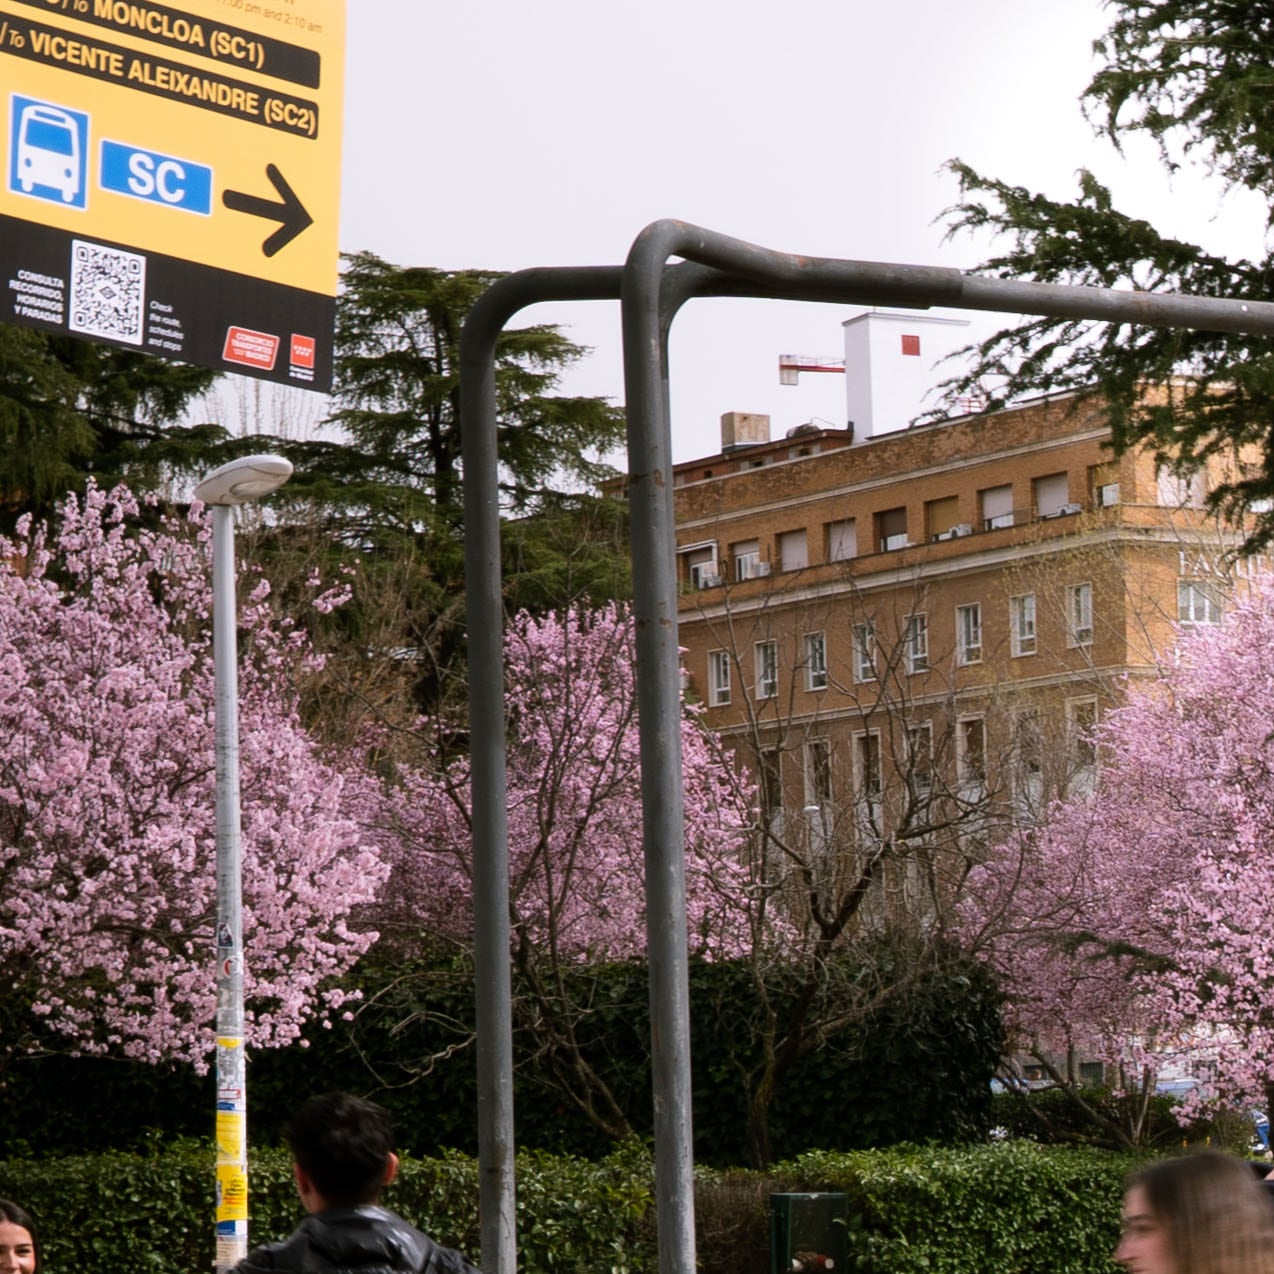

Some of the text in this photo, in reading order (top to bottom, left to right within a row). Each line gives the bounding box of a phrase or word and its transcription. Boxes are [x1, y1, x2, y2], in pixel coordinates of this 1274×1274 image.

[94, 0, 205, 47] MONCLOA
[210, 30, 265, 69] (SC1)
[8, 29, 25, 48] To
[29, 30, 124, 76] VICENTE
[128, 59, 260, 115] ALEIXANDRE
[264, 97, 316, 136] (SC2)
[127, 152, 186, 204] SC
[18, 269, 65, 288] CONSULTA
[14, 304, 21, 315] Y
